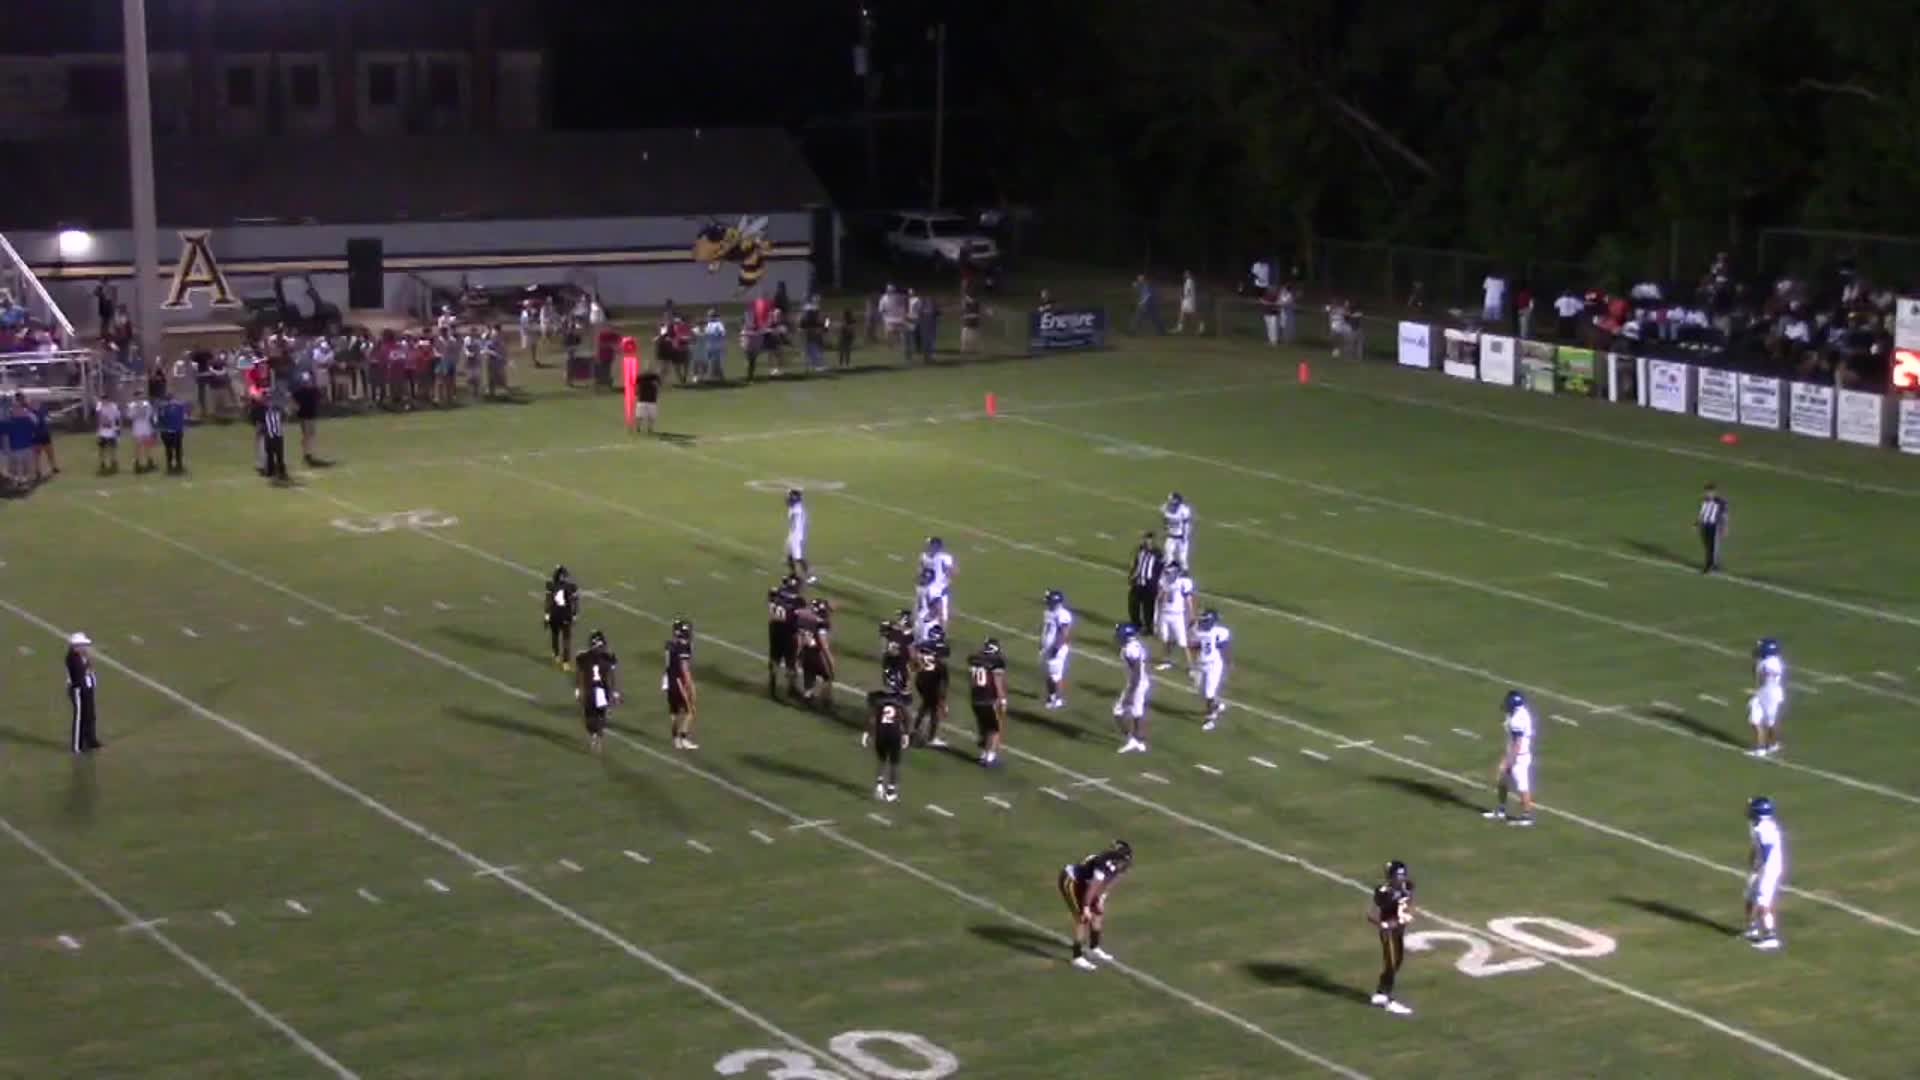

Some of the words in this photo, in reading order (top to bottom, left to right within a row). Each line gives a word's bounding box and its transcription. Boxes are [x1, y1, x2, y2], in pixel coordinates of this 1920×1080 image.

[160, 230, 242, 310] A
[592, 664, 601, 681] 1
[881, 705, 896, 724] 2
[1403, 916, 1617, 978] 20
